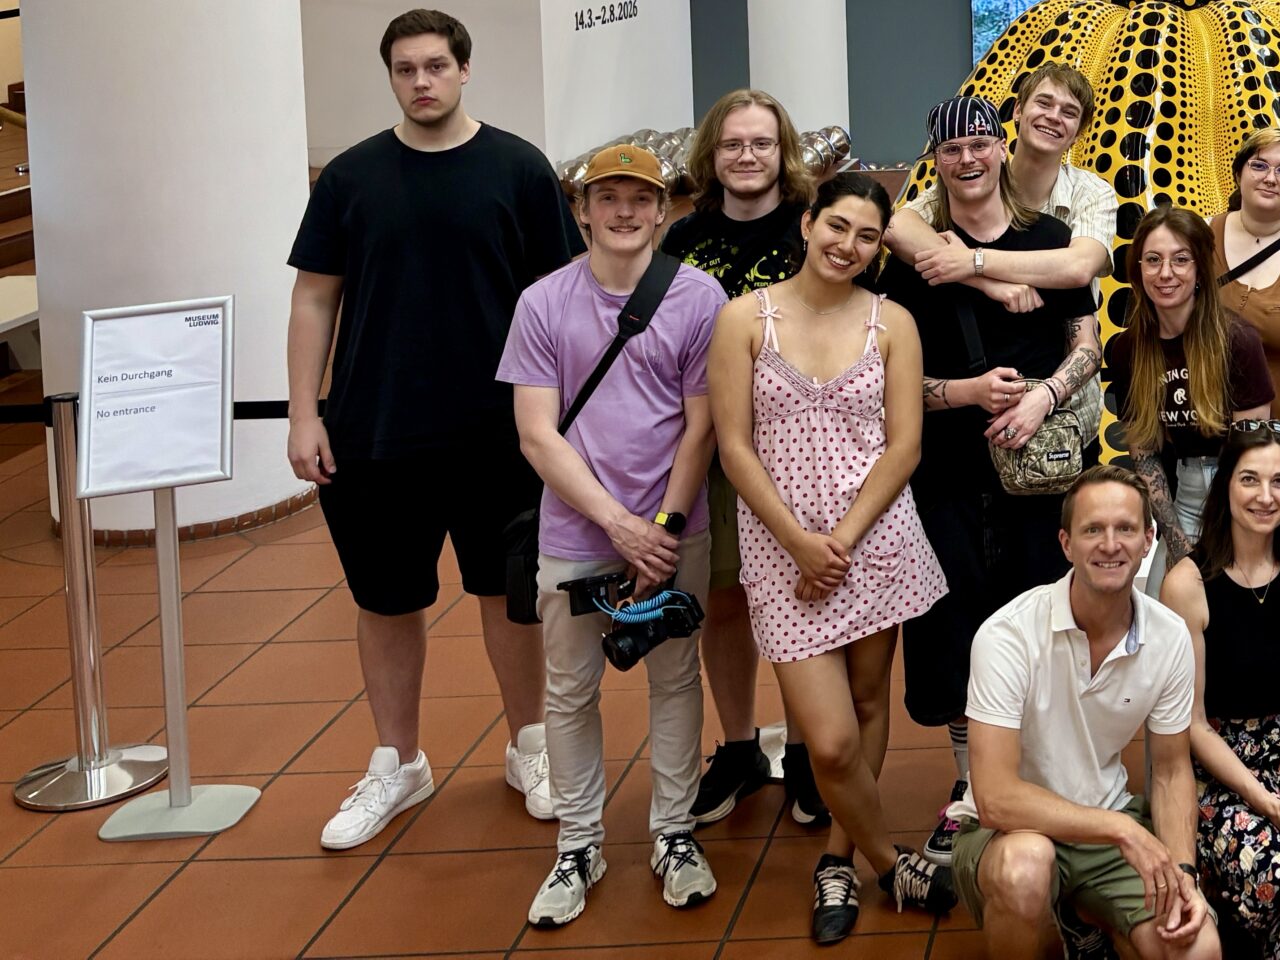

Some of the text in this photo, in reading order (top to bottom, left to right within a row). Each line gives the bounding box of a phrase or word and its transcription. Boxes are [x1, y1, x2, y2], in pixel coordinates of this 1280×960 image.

[184, 313, 219, 323] MUSEUM
[188, 319, 219, 328] LUDWIG
[97, 368, 173, 384] Kein Durchgang
[96, 404, 157, 419] No entrance
